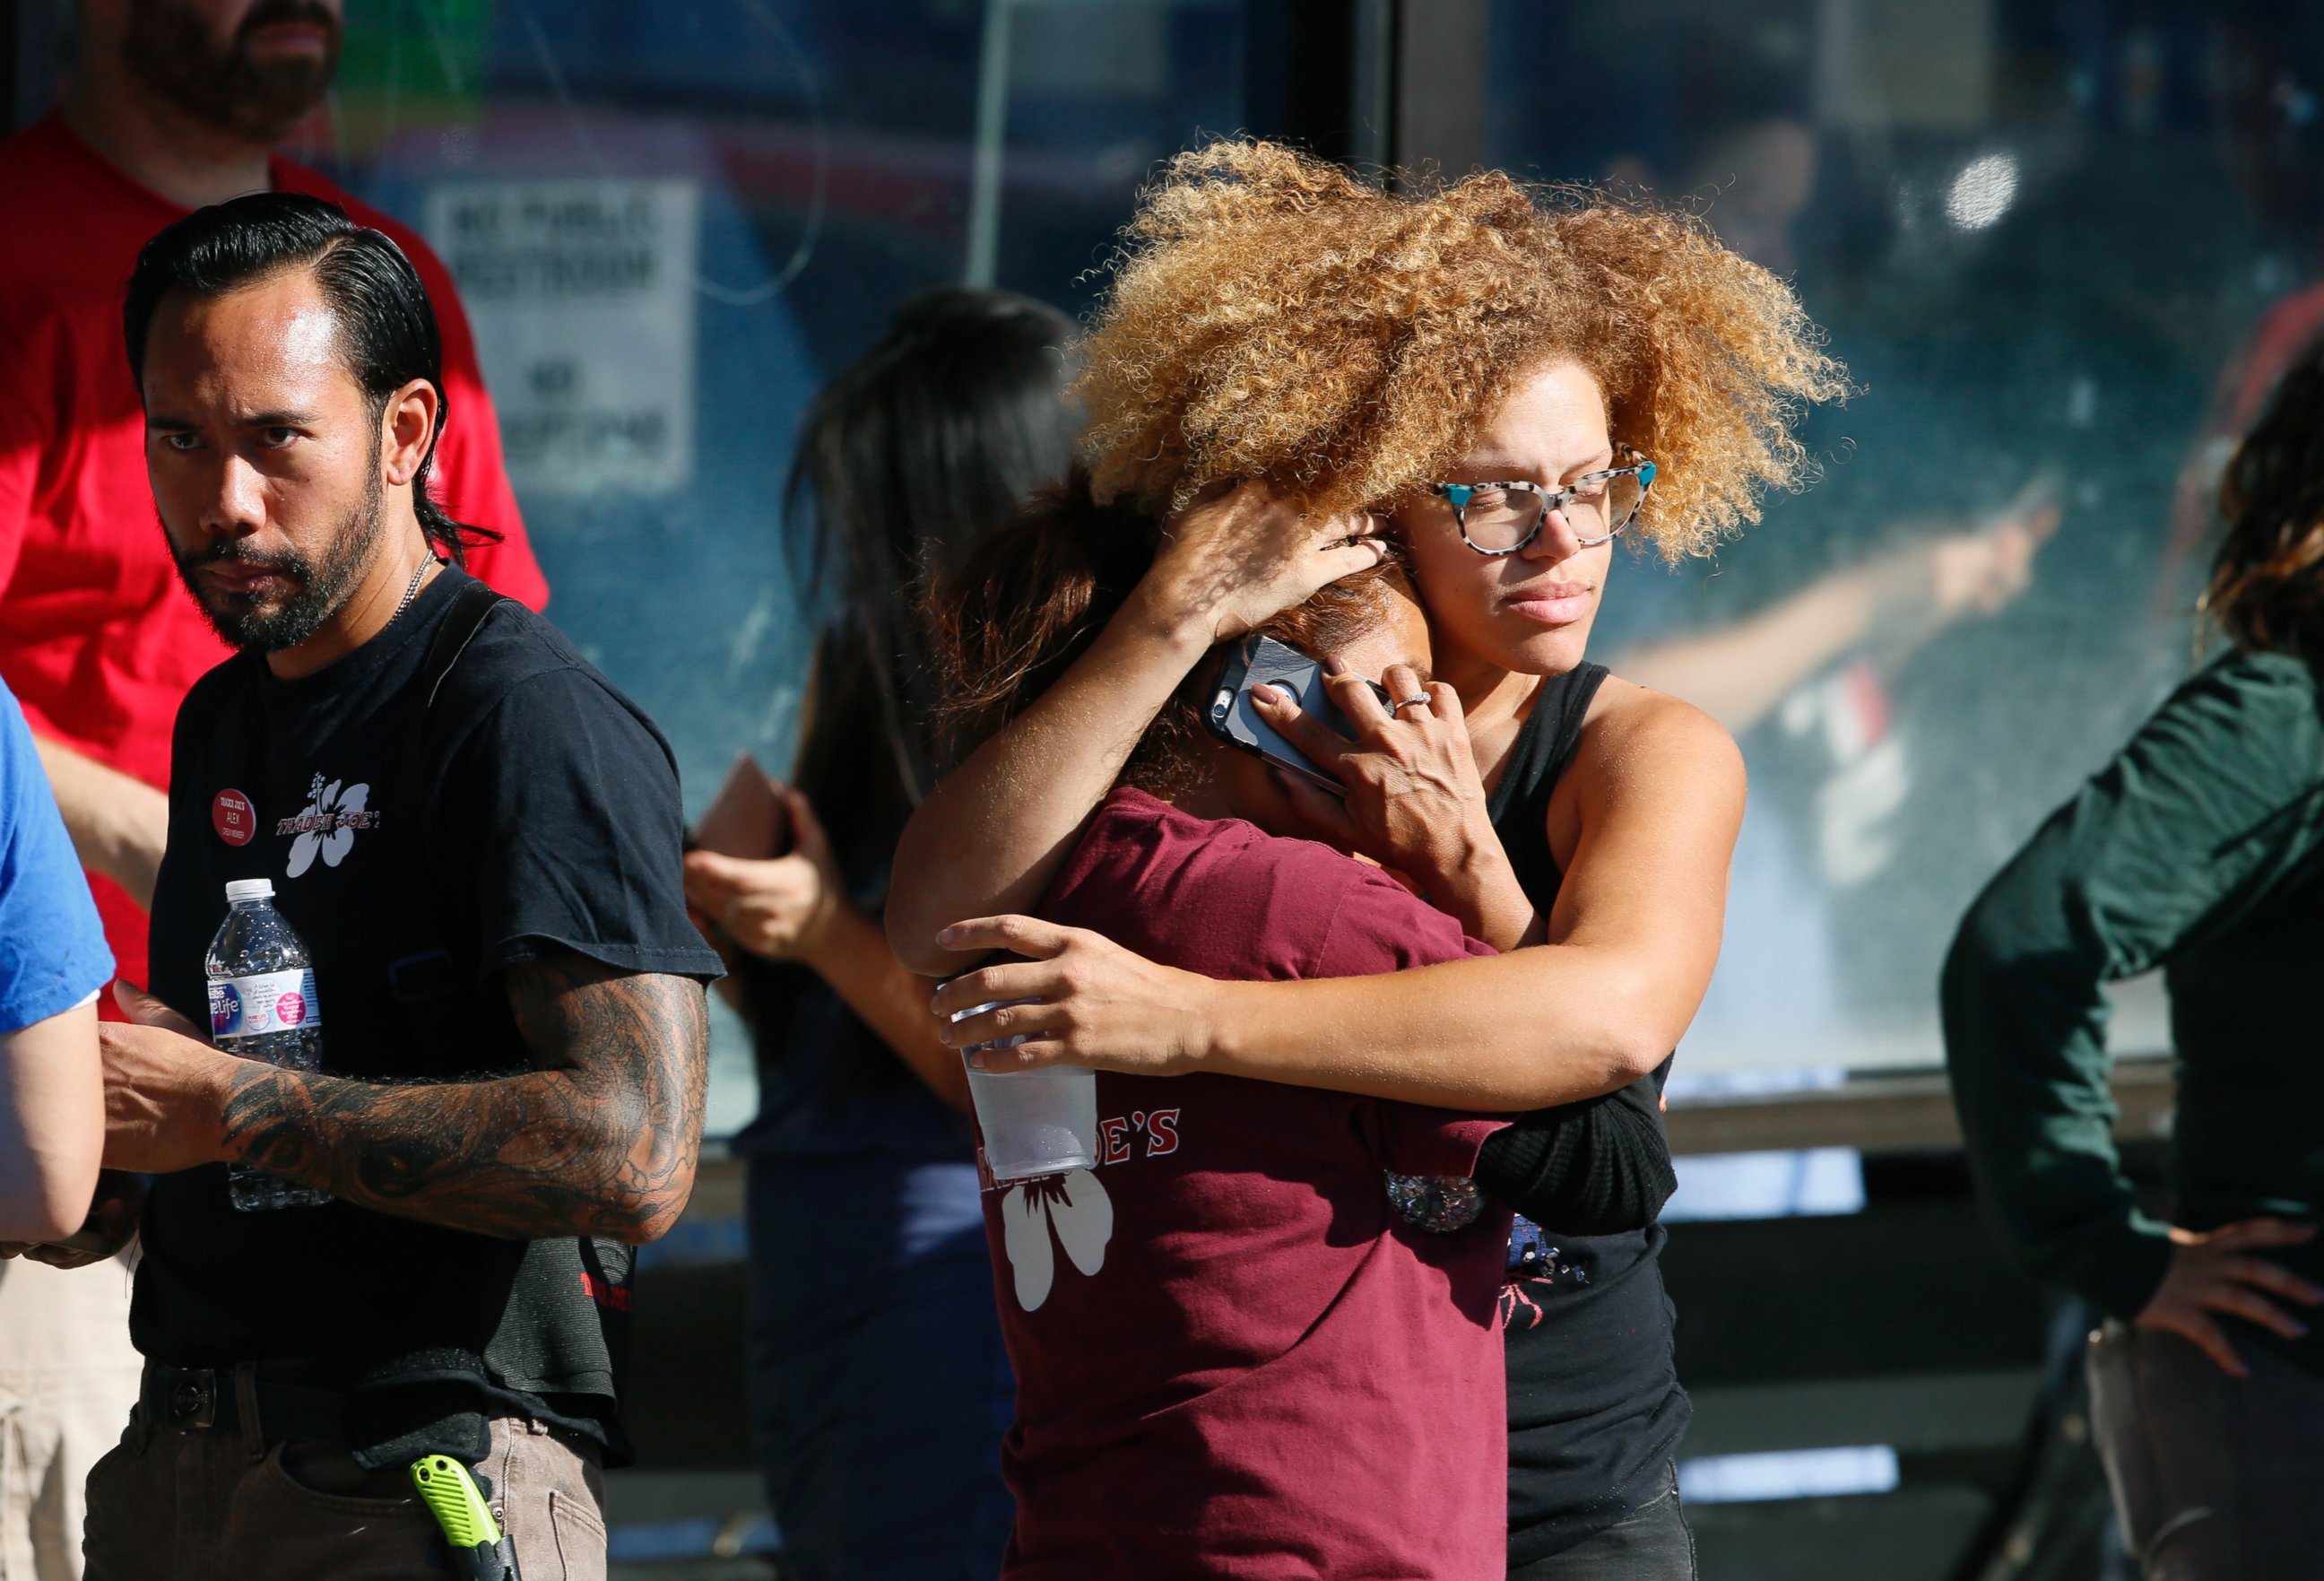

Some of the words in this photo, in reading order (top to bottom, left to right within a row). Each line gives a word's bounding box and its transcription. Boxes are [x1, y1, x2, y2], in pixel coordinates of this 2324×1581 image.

[226, 812, 240, 825] ALEX
[275, 812, 335, 836] TRADER
[1094, 1108, 1181, 1166] E'S
